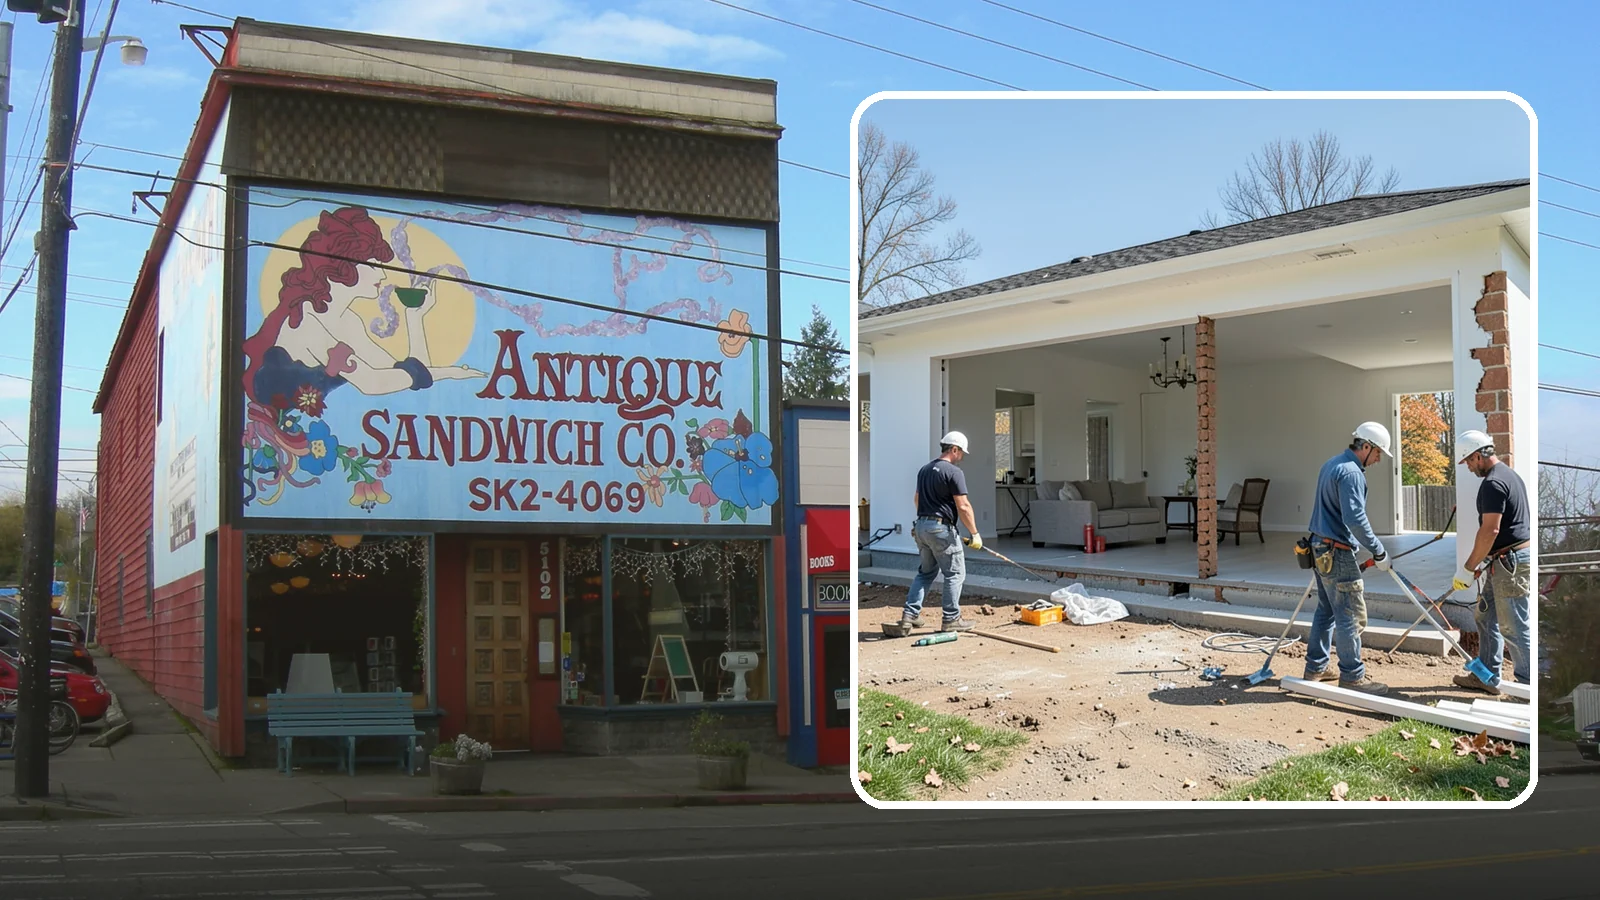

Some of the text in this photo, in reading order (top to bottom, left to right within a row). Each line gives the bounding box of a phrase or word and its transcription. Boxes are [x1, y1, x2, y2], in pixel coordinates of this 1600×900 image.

[475, 329, 723, 420] ANTIQUE
[361, 408, 685, 468] SANDWICH CO.
[469, 477, 645, 513] SK2-4069
[540, 541, 551, 600] 5102
[809, 555, 834, 568] BOOKS
